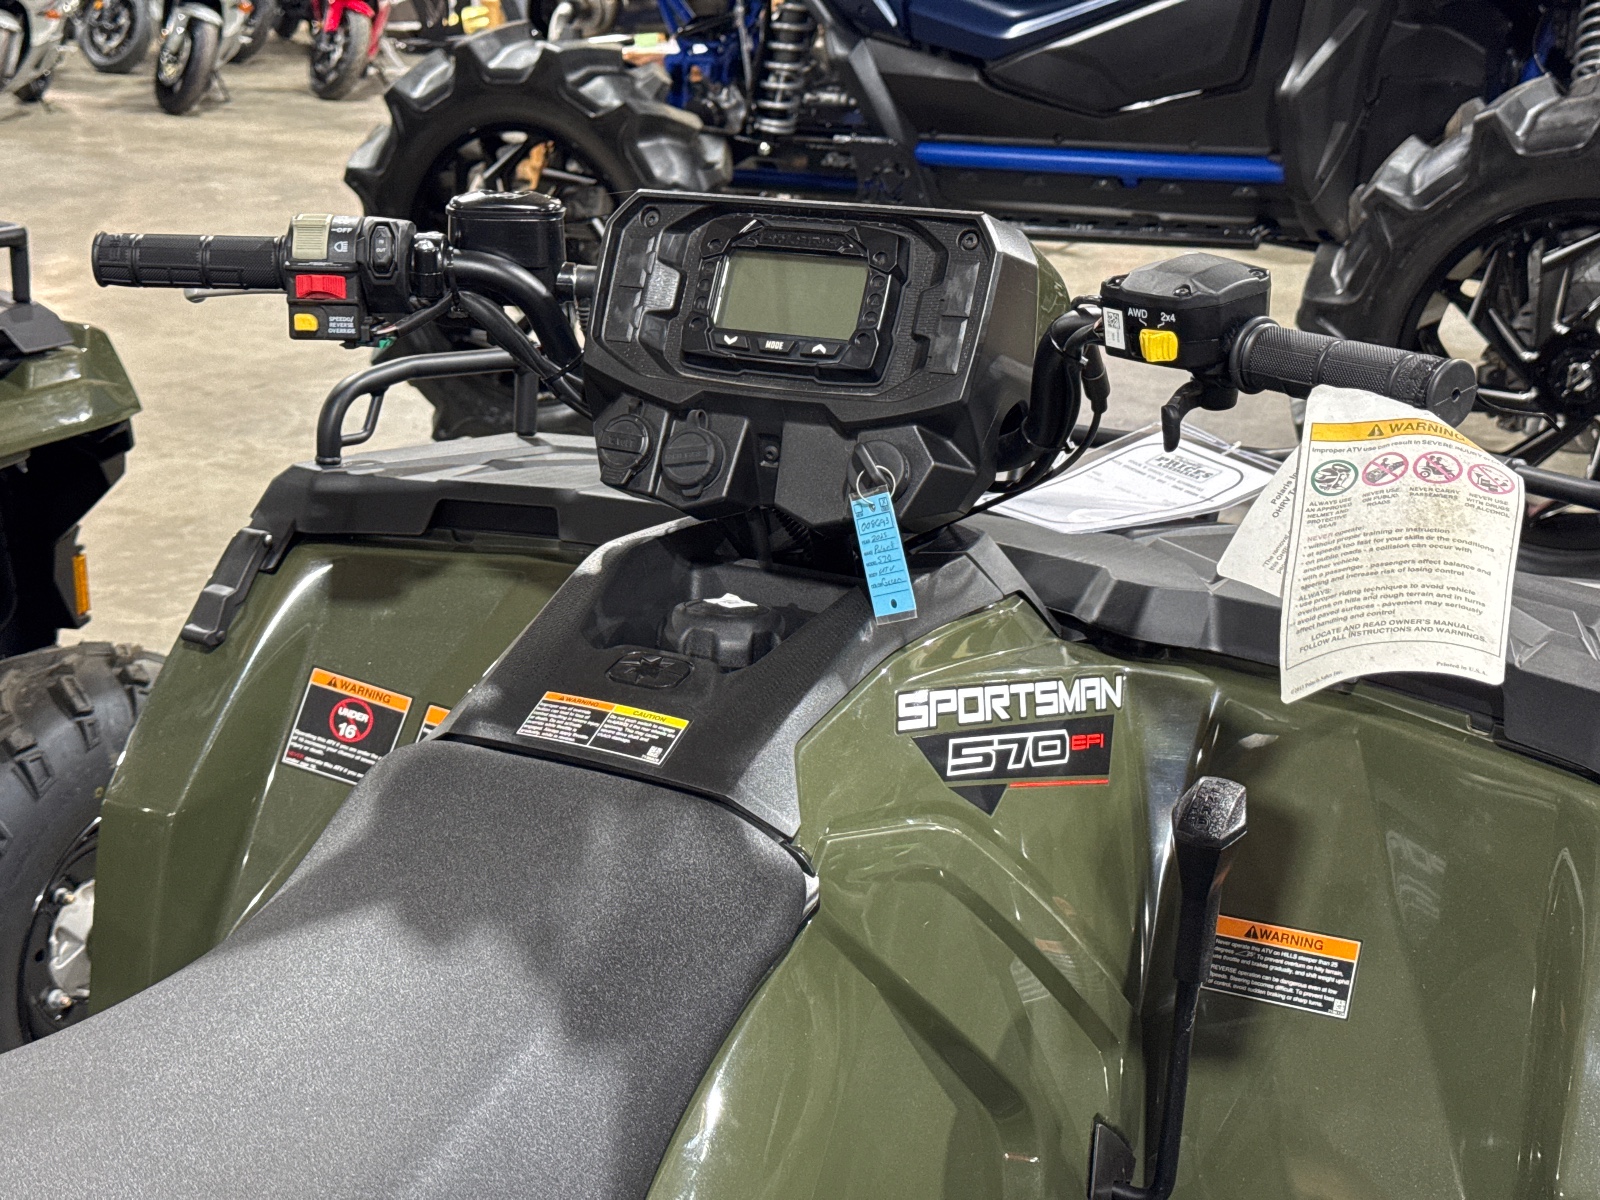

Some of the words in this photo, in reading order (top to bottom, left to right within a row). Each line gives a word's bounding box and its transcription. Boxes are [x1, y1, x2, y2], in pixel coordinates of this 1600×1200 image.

[1128, 307, 1148, 318] AWD
[1160, 312, 1176, 322] 2x4
[765, 340, 784, 350] MODE
[1388, 422, 1467, 442] WARNING
[1422, 440, 1454, 449] SEVERE
[1270, 480, 1293, 505] Polaris
[1409, 492, 1458, 500] PASSENGERS
[1272, 495, 1291, 518] OHRV
[1307, 532, 1333, 542] NEVER
[1308, 540, 1336, 549] without
[1336, 534, 1361, 544] proper
[1363, 528, 1393, 537] training
[1315, 546, 1342, 556] speeds
[1452, 538, 1495, 553] conditions
[1316, 554, 1339, 563] public
[1340, 548, 1362, 557] roads
[1455, 546, 1472, 554] with
[1302, 574, 1318, 582] with
[1325, 564, 1364, 576] passenger
[1370, 560, 1416, 568] passengers
[1443, 560, 1475, 570] balance
[1477, 568, 1491, 576] and
[1303, 563, 1331, 574] another
[1332, 556, 1360, 566] vehicle
[1301, 580, 1329, 590] steering
[1346, 570, 1378, 579] increase
[1434, 568, 1464, 576] control
[1298, 588, 1332, 601] ALWAYS:
[1300, 600, 1312, 608] use
[1313, 593, 1338, 604] proper
[1339, 588, 1362, 597] riding
[1363, 584, 1408, 592] techniques
[1446, 585, 1476, 596] vehicle
[1297, 602, 1332, 617] overturns
[1464, 596, 1486, 607] turns
[1297, 615, 1316, 626] avoid
[1317, 609, 1340, 619] paved
[1341, 603, 1374, 612] surfaces
[1382, 600, 1422, 608] pavement
[1445, 602, 1483, 616] seriously
[1296, 624, 1315, 635] affect
[1316, 616, 1348, 628] handling
[1311, 627, 1342, 641] LOCATE
[1343, 623, 1360, 632] AND
[1362, 620, 1387, 628] READ
[1299, 637, 1330, 653] FOLLOW
[1331, 634, 1346, 642] ALL
[1348, 626, 1412, 638] INSTRUCTIONS
[1436, 627, 1488, 643] WARNINGS.
[339, 680, 392, 704] WARNING
[565, 697, 599, 708] WARNING
[898, 675, 1123, 731] SPORTSMAN
[338, 706, 370, 723] UNDER
[632, 710, 667, 722] CAUTION
[338, 722, 357, 738] 16
[946, 728, 1070, 777] 570
[1071, 733, 1104, 750] EFI
[1259, 928, 1324, 950] WARNING
[1216, 938, 1231, 946] Never
[1231, 942, 1250, 950] operate
[1281, 951, 1298, 960] HILLS
[1298, 955, 1318, 963] steeper
[1223, 955, 1240, 963] throttle
[1251, 961, 1268, 969] brakes
[1269, 965, 1294, 975] gradually,
[1284, 960, 1306, 969] overturn
[1314, 965, 1324, 974] hilly
[1325, 968, 1343, 977] terrain,
[1211, 963, 1237, 974] REVERSE
[1238, 970, 1261, 979] operation
[1280, 978, 1307, 988] dangerous
